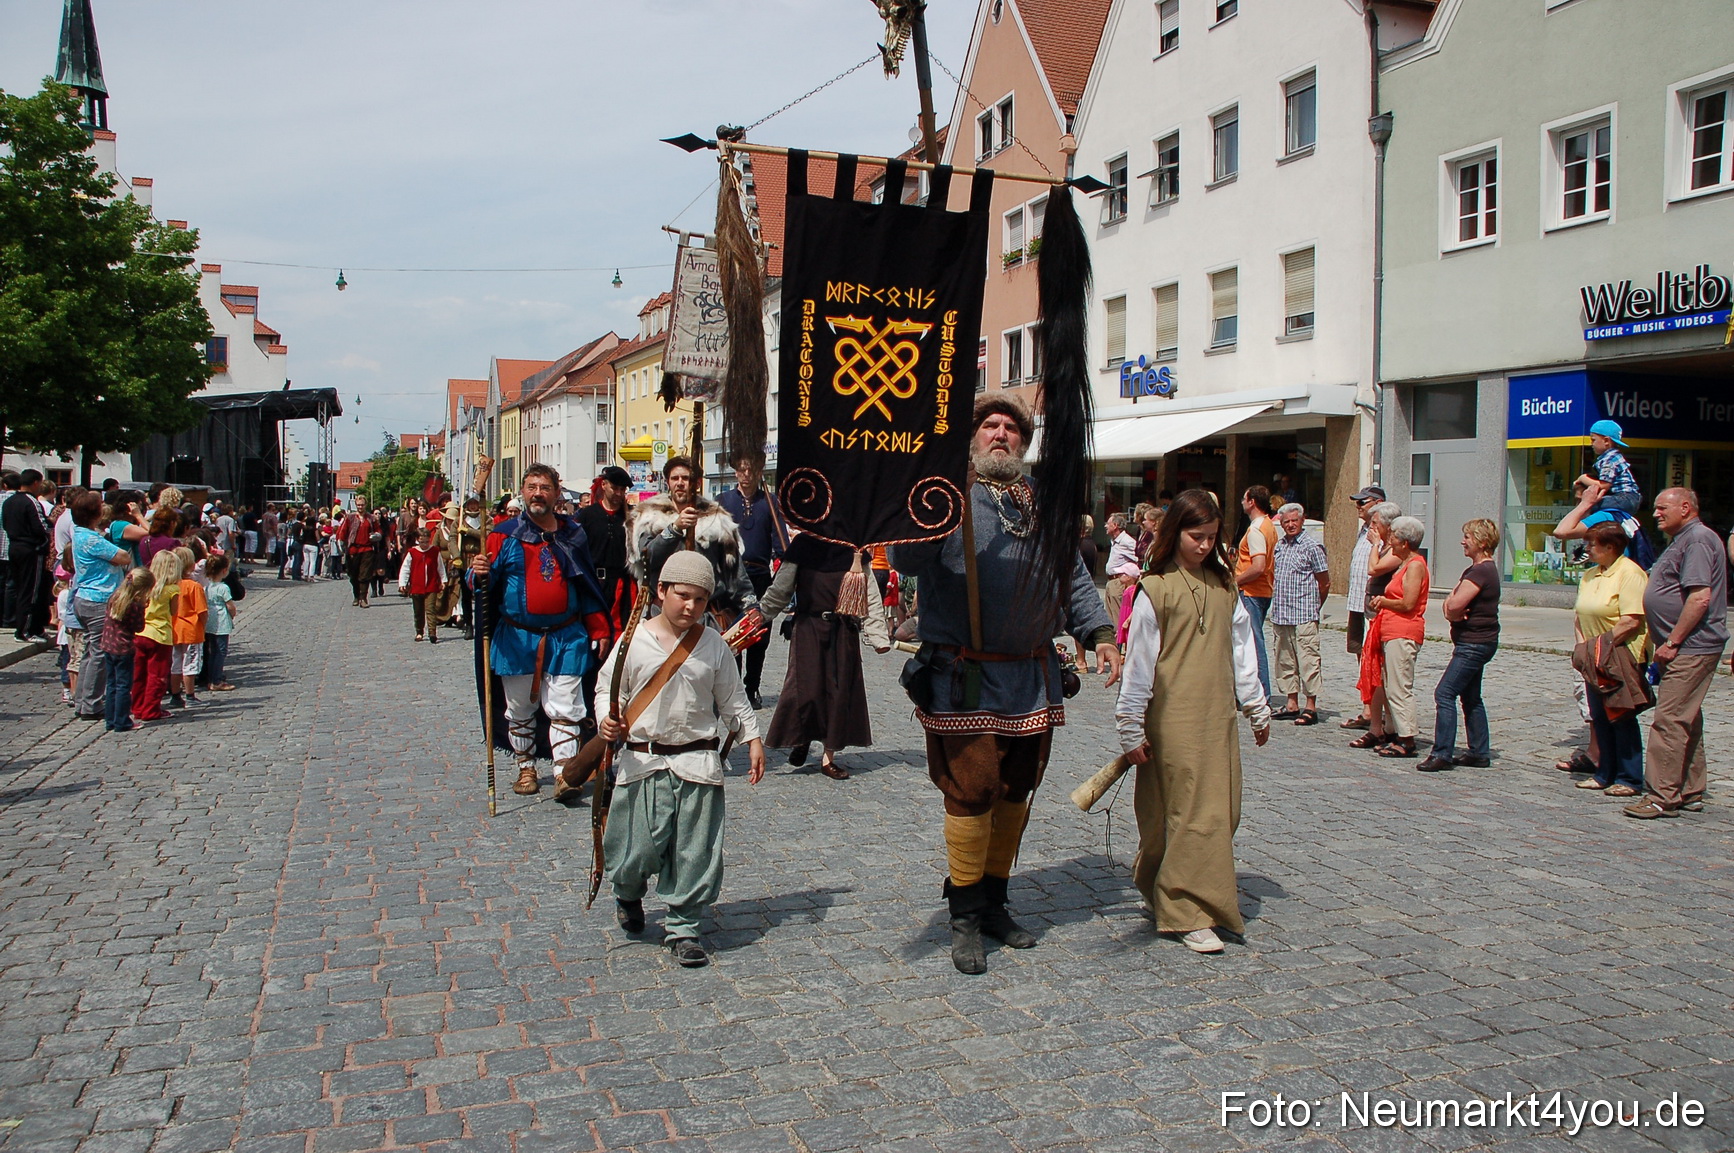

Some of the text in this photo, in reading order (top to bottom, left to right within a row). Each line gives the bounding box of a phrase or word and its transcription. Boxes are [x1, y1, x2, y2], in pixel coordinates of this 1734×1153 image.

[1580, 263, 1734, 324] Weltb
[1587, 314, 1714, 340] BÜCHER MUSIK VIDEOS
[1521, 396, 1573, 417] Bücher
[1604, 391, 1674, 420] Videos
[1517, 510, 1553, 520] Weltbild
